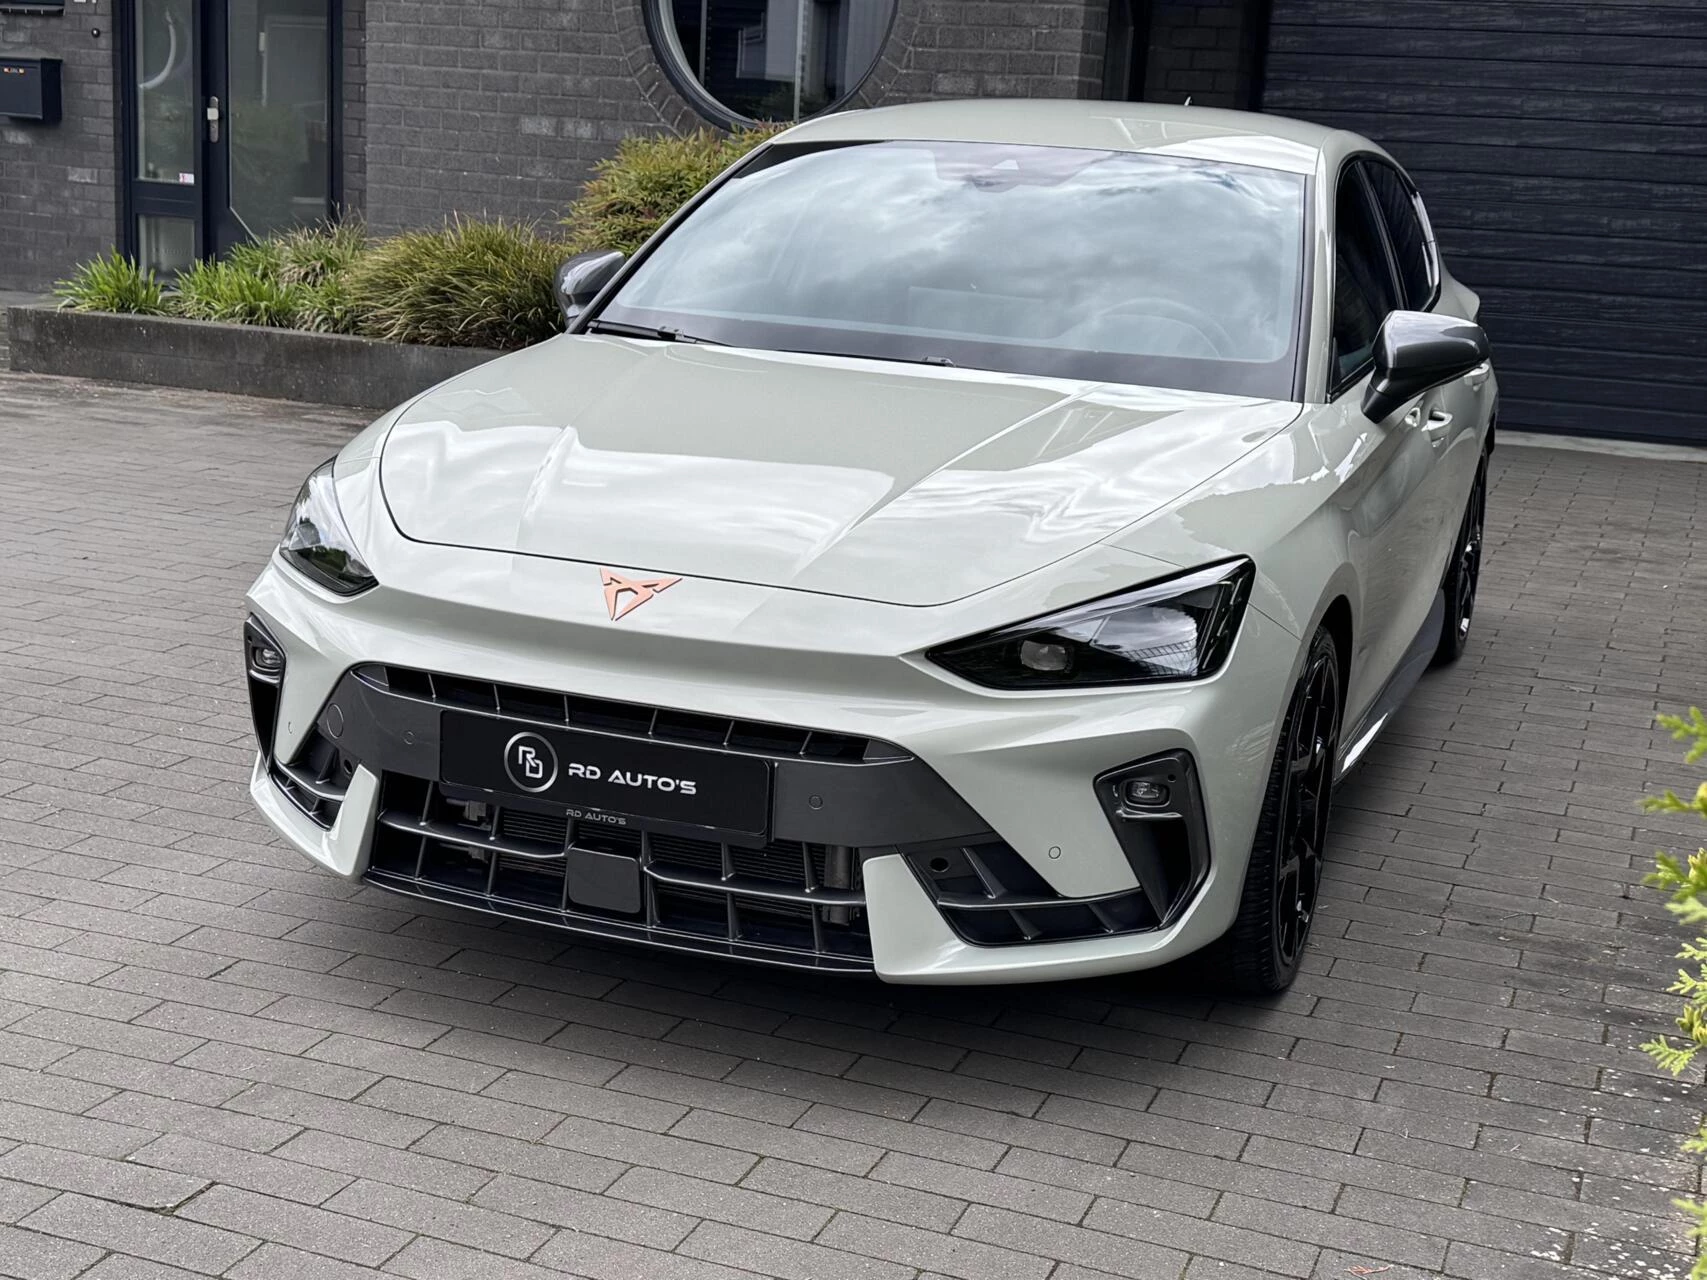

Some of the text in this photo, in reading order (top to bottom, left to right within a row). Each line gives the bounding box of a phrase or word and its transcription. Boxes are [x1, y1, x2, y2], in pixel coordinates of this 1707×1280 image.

[568, 763, 697, 795] RD AUTO'S
[566, 809, 626, 825] RD AUTO'S
